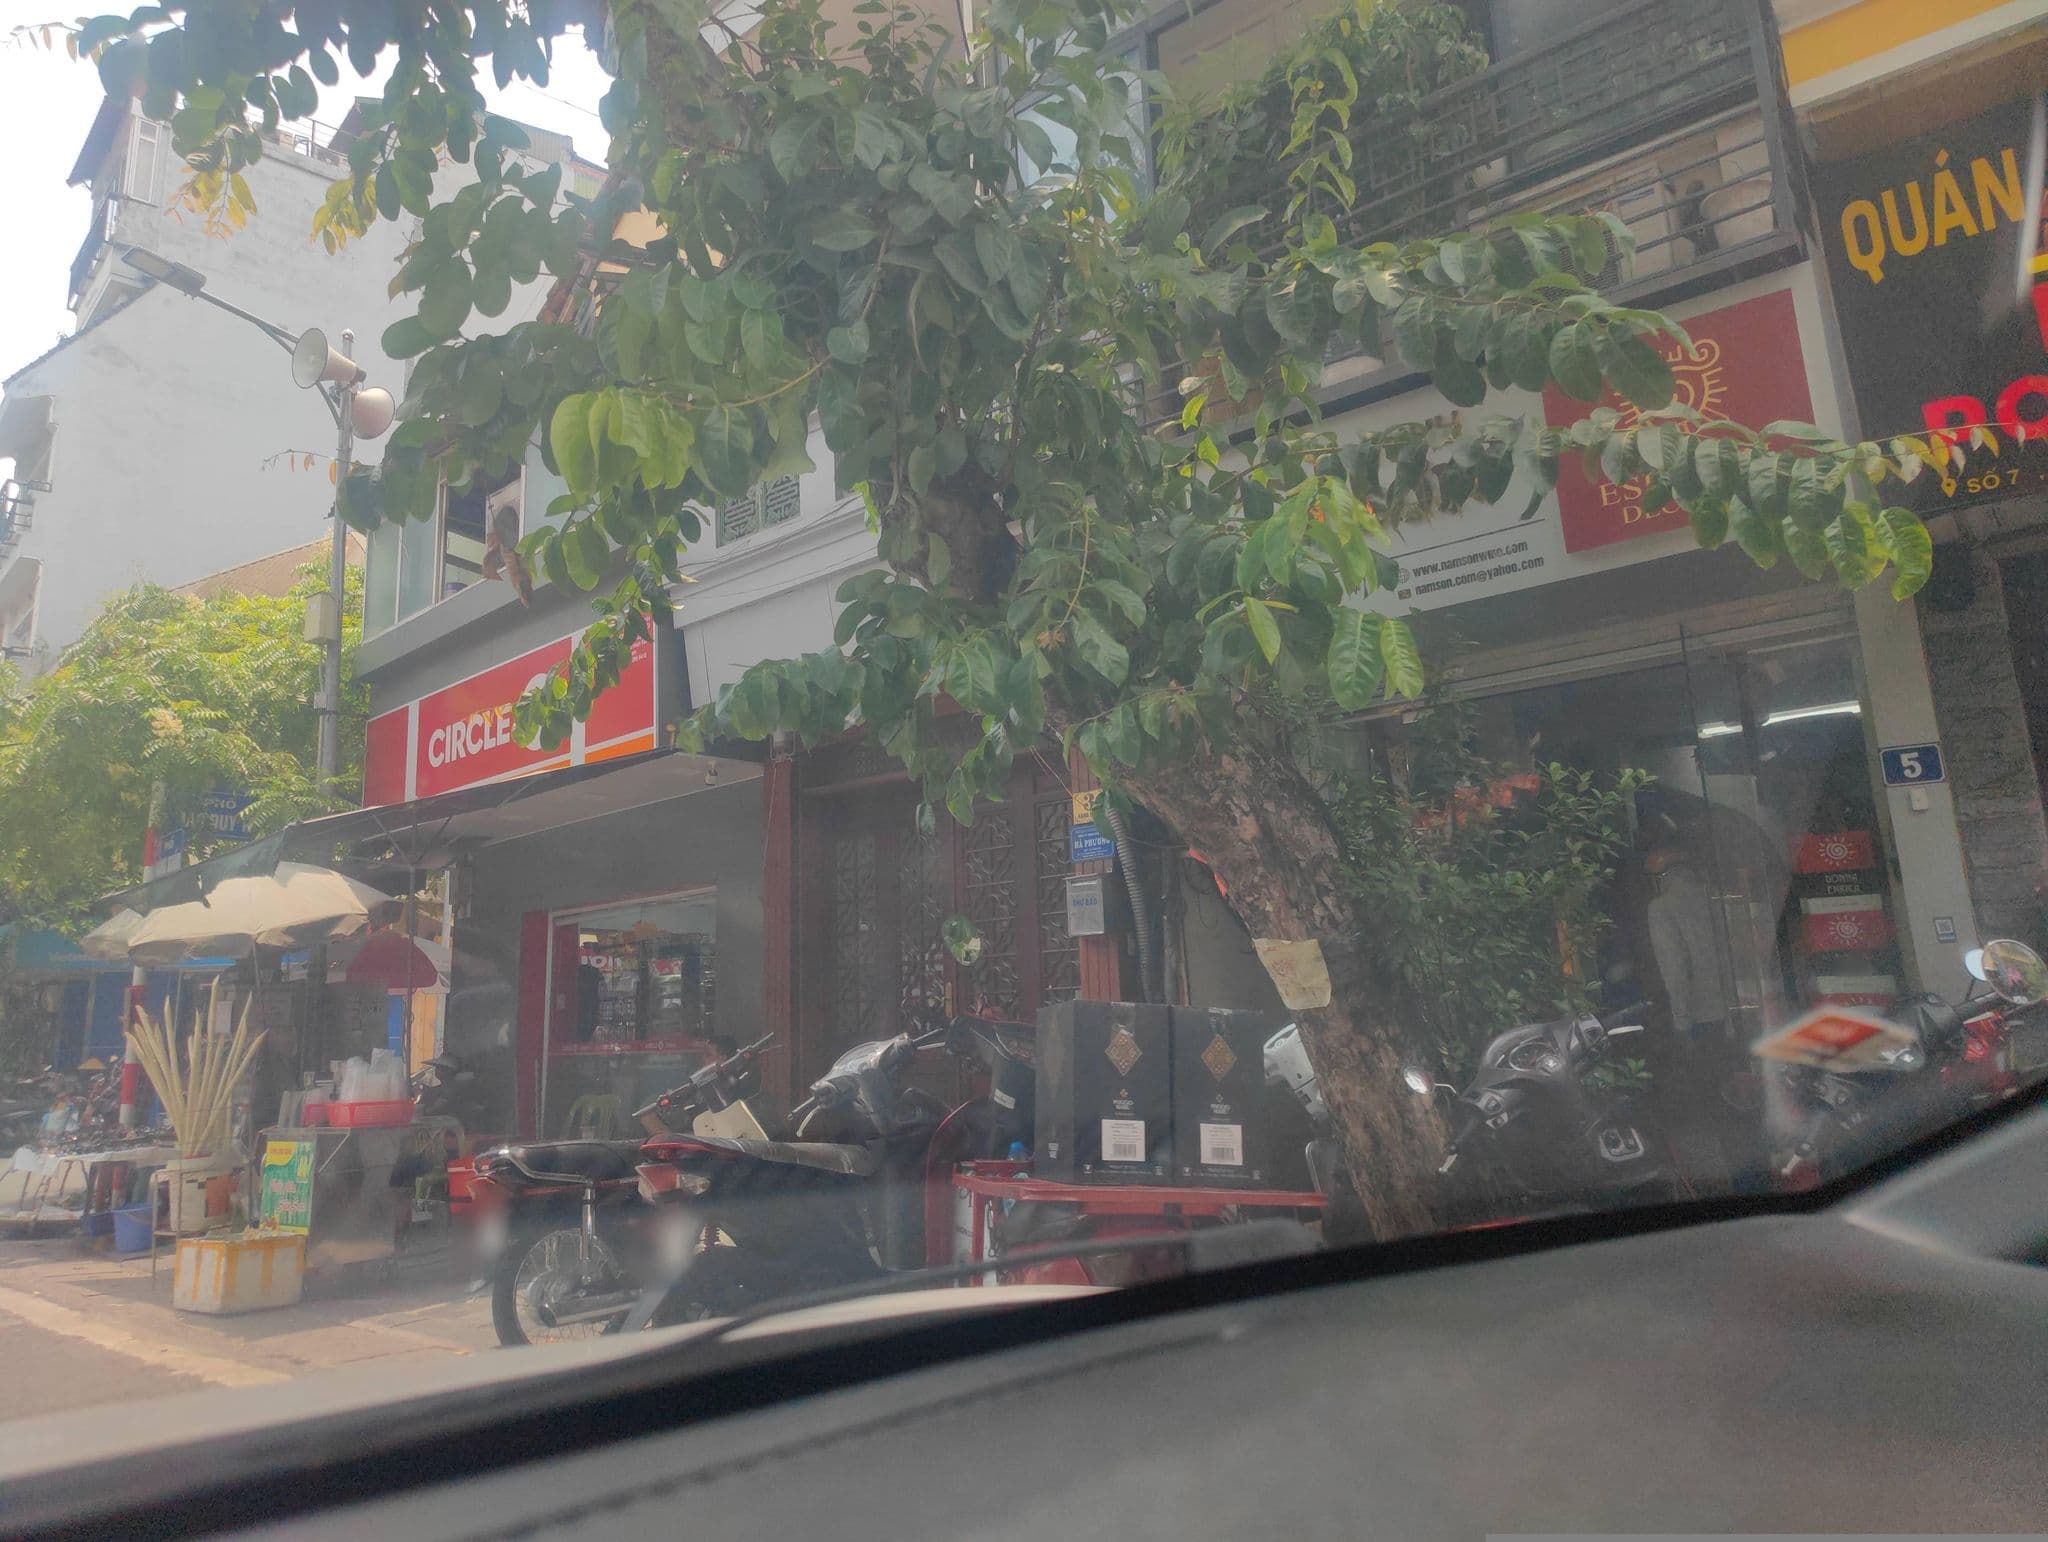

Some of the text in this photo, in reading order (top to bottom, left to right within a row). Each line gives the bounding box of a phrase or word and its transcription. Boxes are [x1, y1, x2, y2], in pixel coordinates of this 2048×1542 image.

[1841, 148, 2025, 284] QUÁN
[1966, 466, 2020, 494] SỐ 7
[1415, 556, 1545, 596] namson.com@yahoo.com
[428, 702, 513, 768] CIRCLE
[1900, 752, 1922, 779] 5
